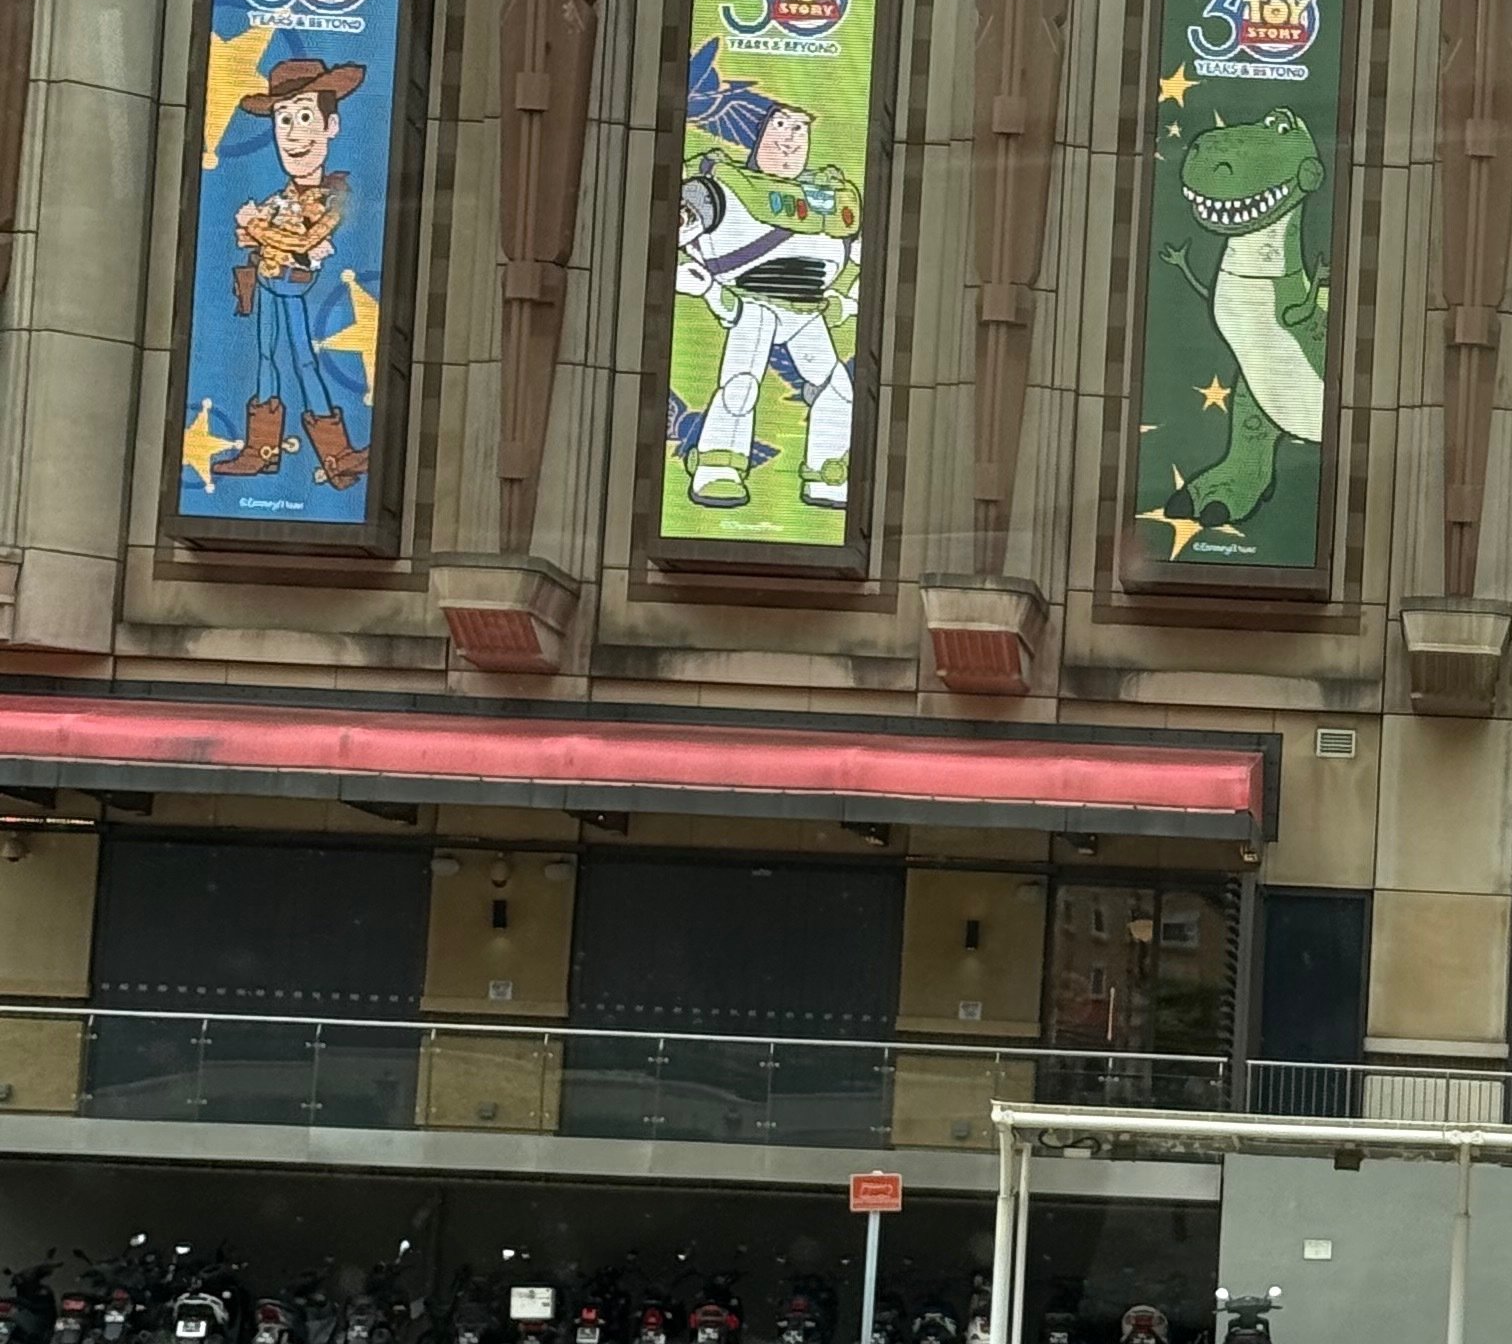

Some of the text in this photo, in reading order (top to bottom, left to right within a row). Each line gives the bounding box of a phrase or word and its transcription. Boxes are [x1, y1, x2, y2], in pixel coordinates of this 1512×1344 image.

[779, 2, 835, 16] STORY
[251, 13, 293, 27] YEARS
[308, 17, 361, 30] BEYOND
[1247, 27, 1302, 40] STORY
[729, 38, 769, 50] YEARS
[783, 41, 839, 54] BEYOND
[1196, 62, 1238, 75] YEARS
[1253, 66, 1305, 77] BEYOND
